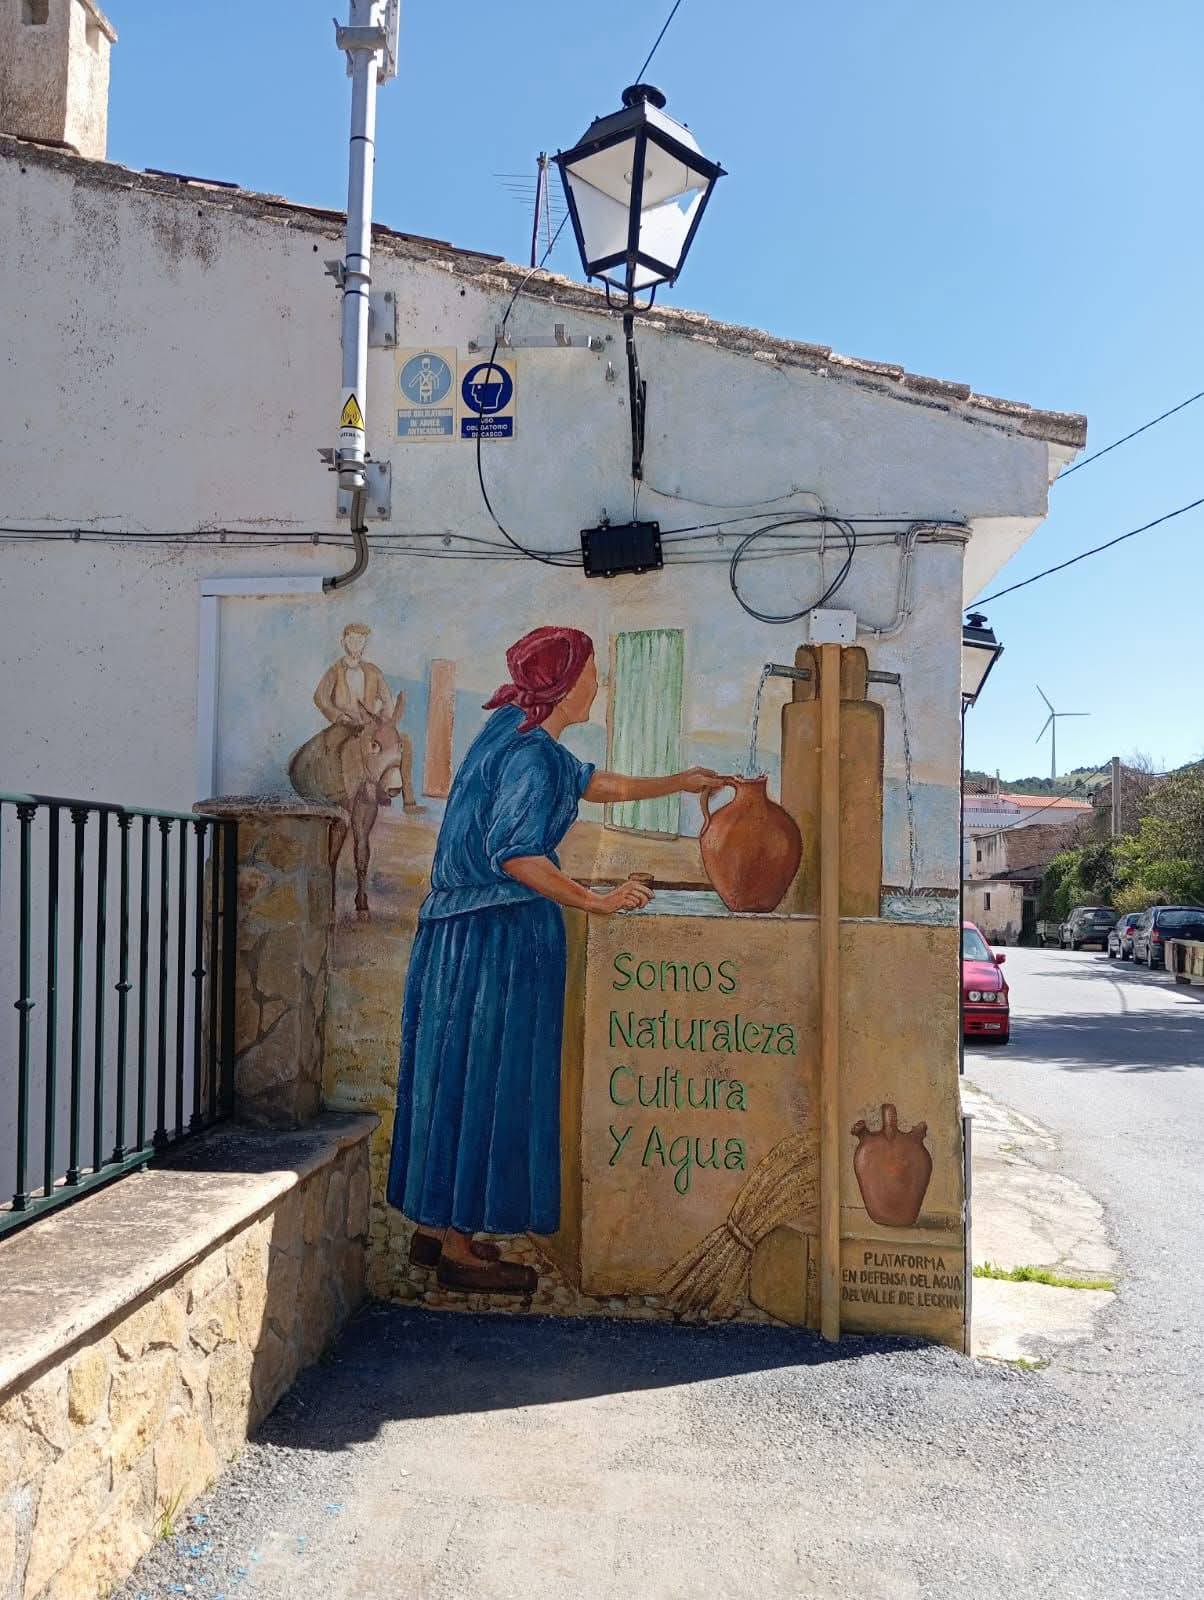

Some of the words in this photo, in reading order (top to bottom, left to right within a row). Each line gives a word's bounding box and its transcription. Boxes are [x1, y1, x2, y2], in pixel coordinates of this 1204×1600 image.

[612, 952, 738, 994] Somos
[608, 1010, 798, 1055] Naturaleza
[608, 1065, 748, 1111] Cultura
[641, 1126, 746, 1194] Agua
[842, 1269, 857, 1283] EN
[860, 1270, 908, 1287] DEFENSA
[910, 1273, 931, 1289] DEL
[932, 1274, 962, 1291] AGUA
[864, 1251, 946, 1271] PLATAFORMA
[860, 1288, 896, 1304] VALLE
[898, 1291, 915, 1306] DE
